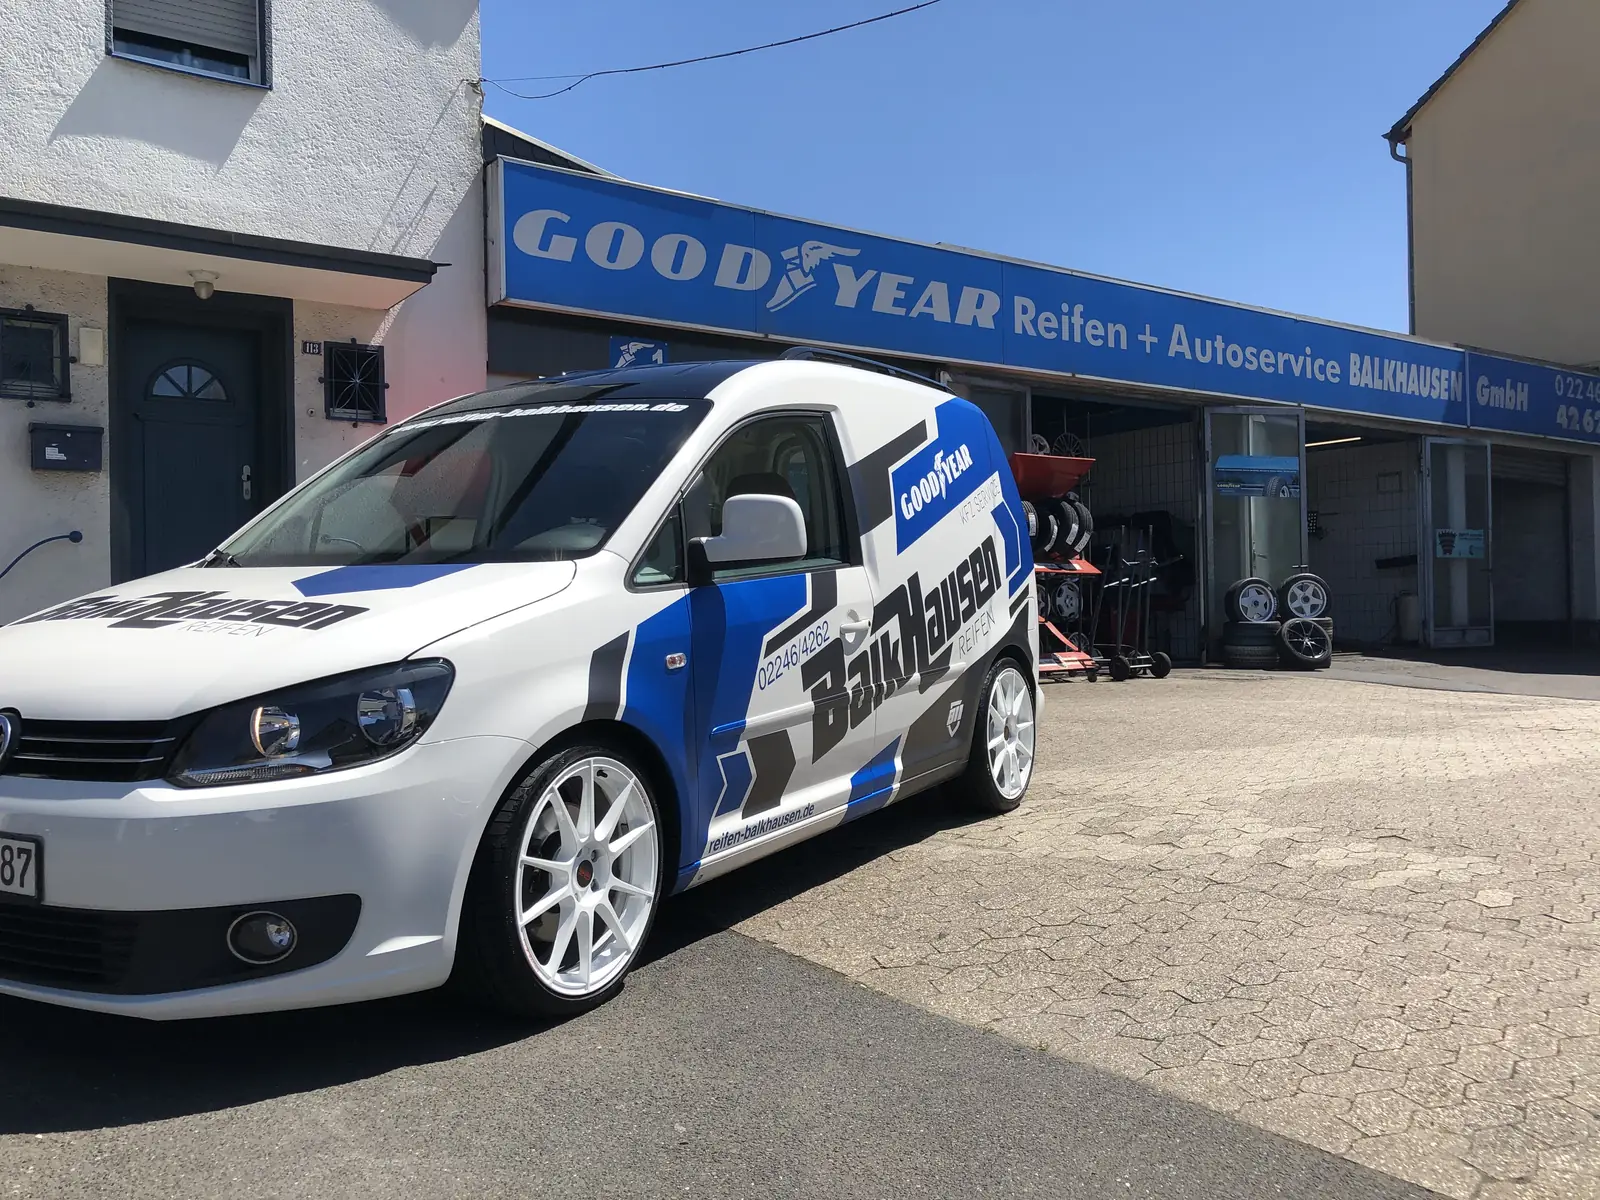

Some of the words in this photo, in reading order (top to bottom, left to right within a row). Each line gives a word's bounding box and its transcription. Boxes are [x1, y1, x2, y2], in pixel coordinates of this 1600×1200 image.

[513, 209, 1000, 330] GOODYEAR
[1014, 296, 1128, 350] Reifen
[1168, 324, 1340, 385] Autoservice
[1349, 352, 1463, 402] BALKHAUSEN
[1476, 375, 1529, 412] GmbH
[900, 443, 974, 520] GOODYEAR
[178, 620, 276, 638] REIFEN
[959, 610, 996, 660] REIFEN
[758, 620, 831, 691] 02246/4262
[708, 802, 815, 853] reifen-balkhausen.de
[0, 845, 32, 889] 87
